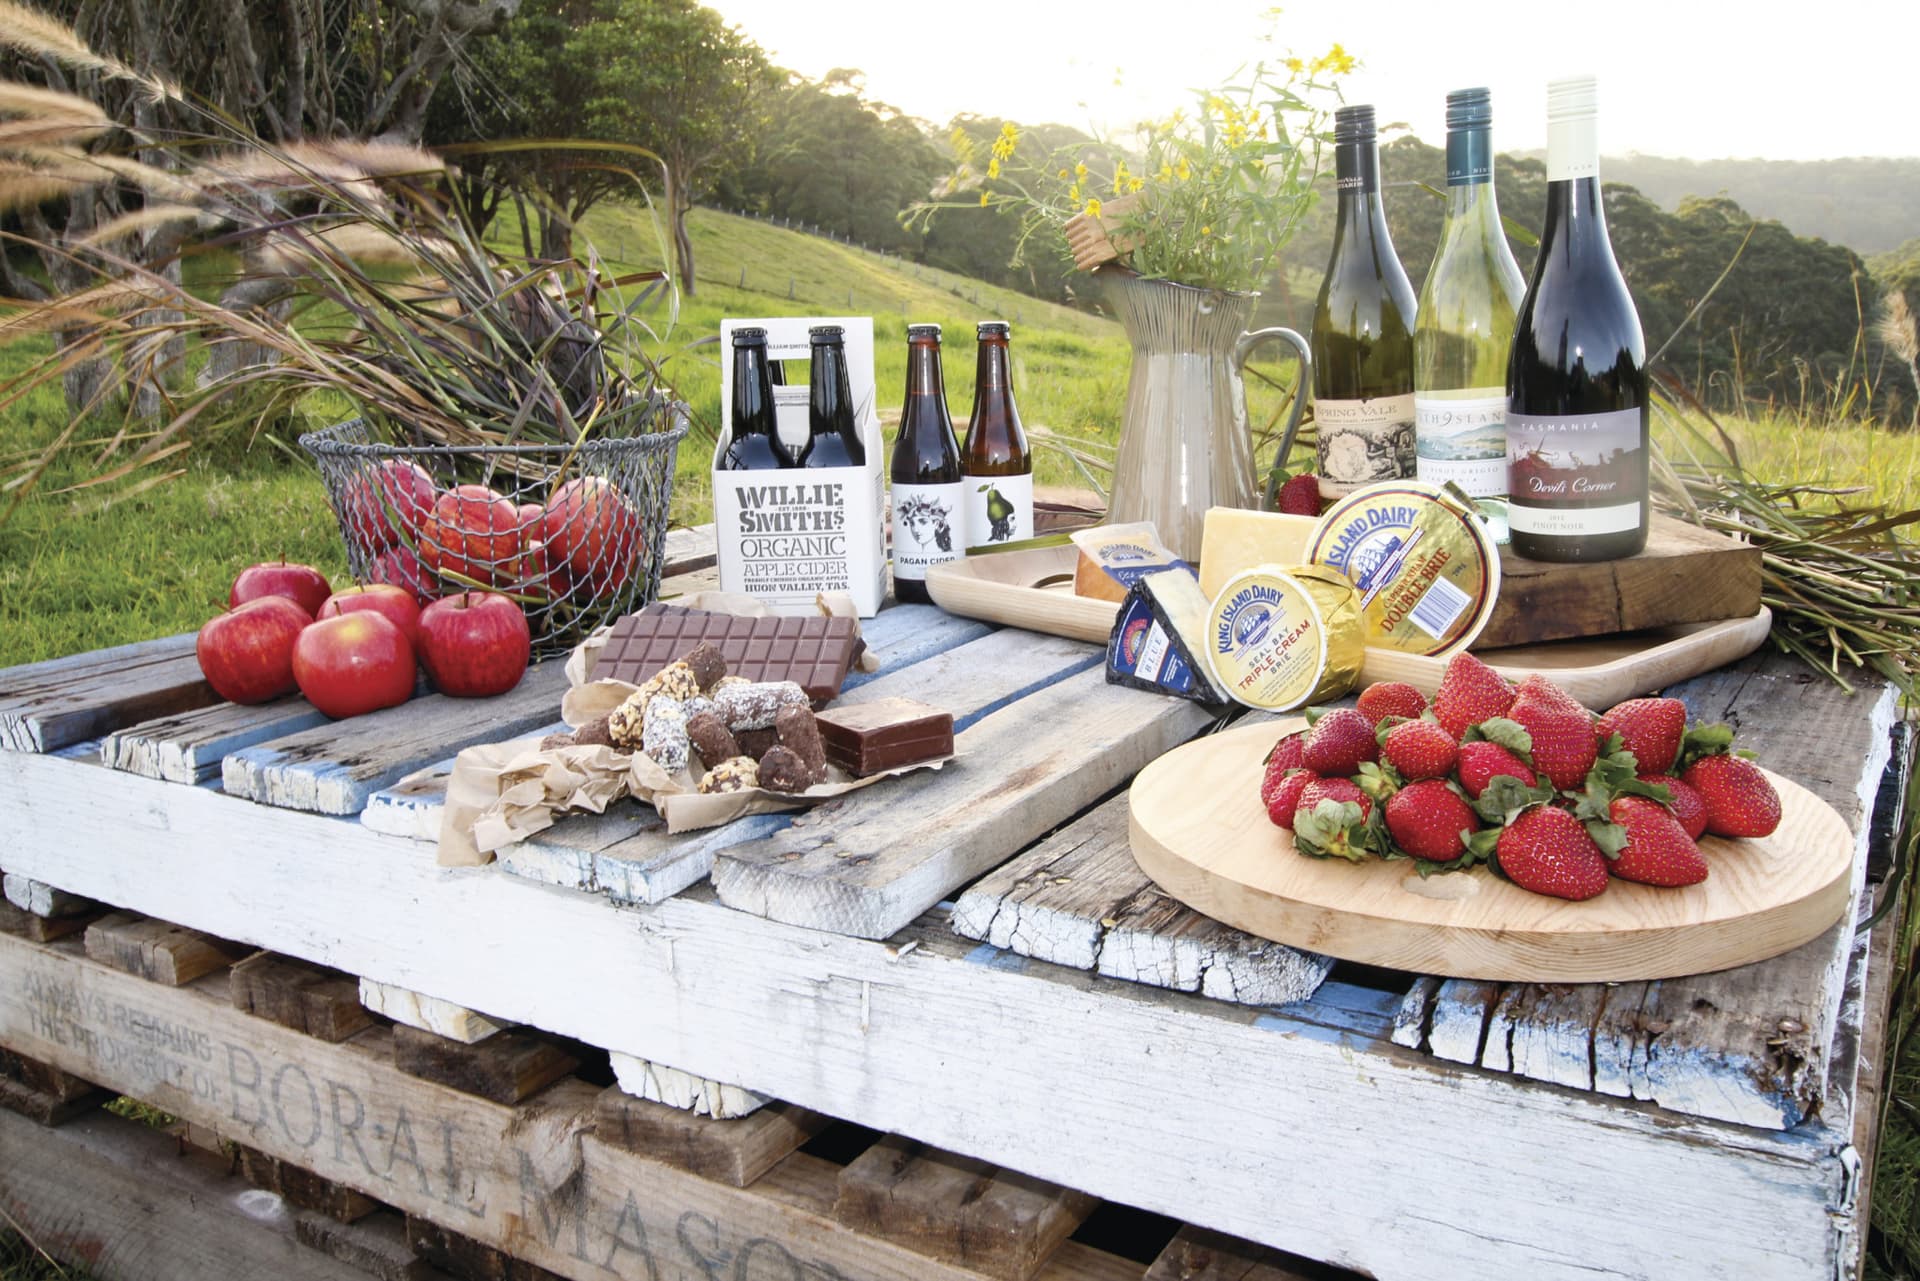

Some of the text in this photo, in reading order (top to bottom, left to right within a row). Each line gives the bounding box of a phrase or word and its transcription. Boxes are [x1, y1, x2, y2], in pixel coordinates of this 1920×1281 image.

[1521, 421, 1599, 432] TASMANIA
[735, 483, 844, 509] WILLIE
[1572, 477, 1617, 494] Corner
[740, 536, 847, 558] ORGANIC
[1324, 506, 1419, 567] ISLAND DAIRY
[743, 560, 849, 577] APPLE CIDER
[900, 556, 928, 566] PAGAN
[744, 581, 850, 593] HUON VALLEY, TAS.
[1251, 584, 1284, 604] DAIRY
[1380, 579, 1428, 633] DOUBLE
[1420, 547, 1452, 582] BRIE
[1220, 588, 1252, 623] ISLAND
[1217, 623, 1234, 654] KING
[1248, 626, 1290, 669] SEAL BAY
[1238, 655, 1276, 691] TRIPLE
[1275, 619, 1311, 657] CREAM
[1270, 652, 1292, 675] BRIE
[24, 1002, 68, 1045] THE
[221, 1041, 487, 1219] BORAL
